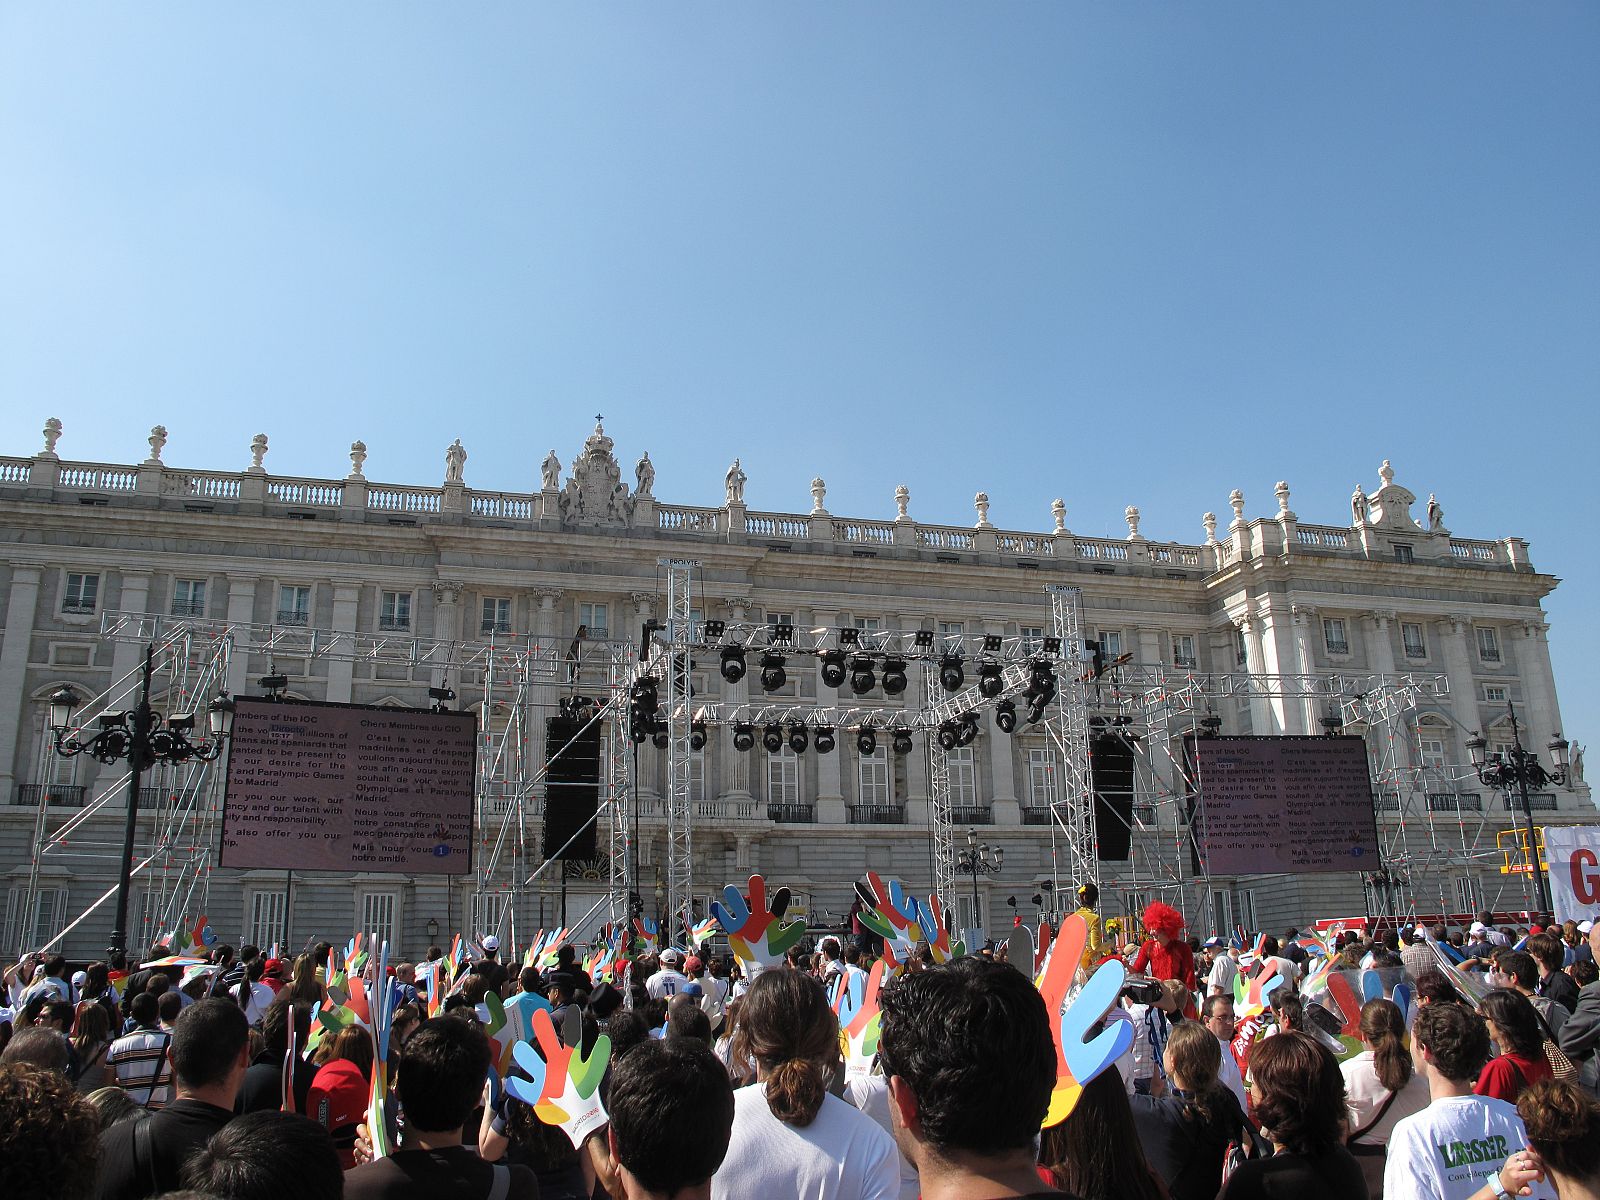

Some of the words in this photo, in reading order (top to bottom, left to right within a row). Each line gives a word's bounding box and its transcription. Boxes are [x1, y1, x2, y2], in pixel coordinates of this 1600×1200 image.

[234, 712, 268, 721] embers
[271, 713, 279, 721] of
[300, 715, 318, 723] IOC
[361, 720, 386, 728] Chers
[389, 722, 429, 731] Membres
[444, 725, 461, 733] CIO
[232, 736, 258, 744] nians
[281, 740, 326, 749] spaniards
[437, 737, 448, 745] de
[297, 752, 333, 761] present
[432, 747, 473, 758] d'espagn
[268, 759, 300, 767] desire
[308, 760, 322, 768] for
[358, 754, 397, 763] voulions
[236, 767, 254, 775] and
[258, 769, 309, 779] Paralympic
[313, 772, 344, 780] Games
[382, 765, 399, 773] afin
[402, 766, 413, 774] de
[441, 768, 473, 777] exprim
[356, 784, 409, 794] Olympiques
[430, 788, 471, 797] Paralymp
[293, 796, 320, 804] work,
[226, 803, 248, 811] ency
[323, 807, 342, 815] with
[355, 808, 378, 817] Nous
[410, 811, 441, 819] offrons
[242, 813, 260, 821] and
[263, 815, 328, 825] responsibility.
[384, 821, 430, 829] constance
[236, 828, 258, 836] also
[265, 830, 291, 838] offer
[298, 832, 317, 840] you
[353, 843, 374, 851] Mais
